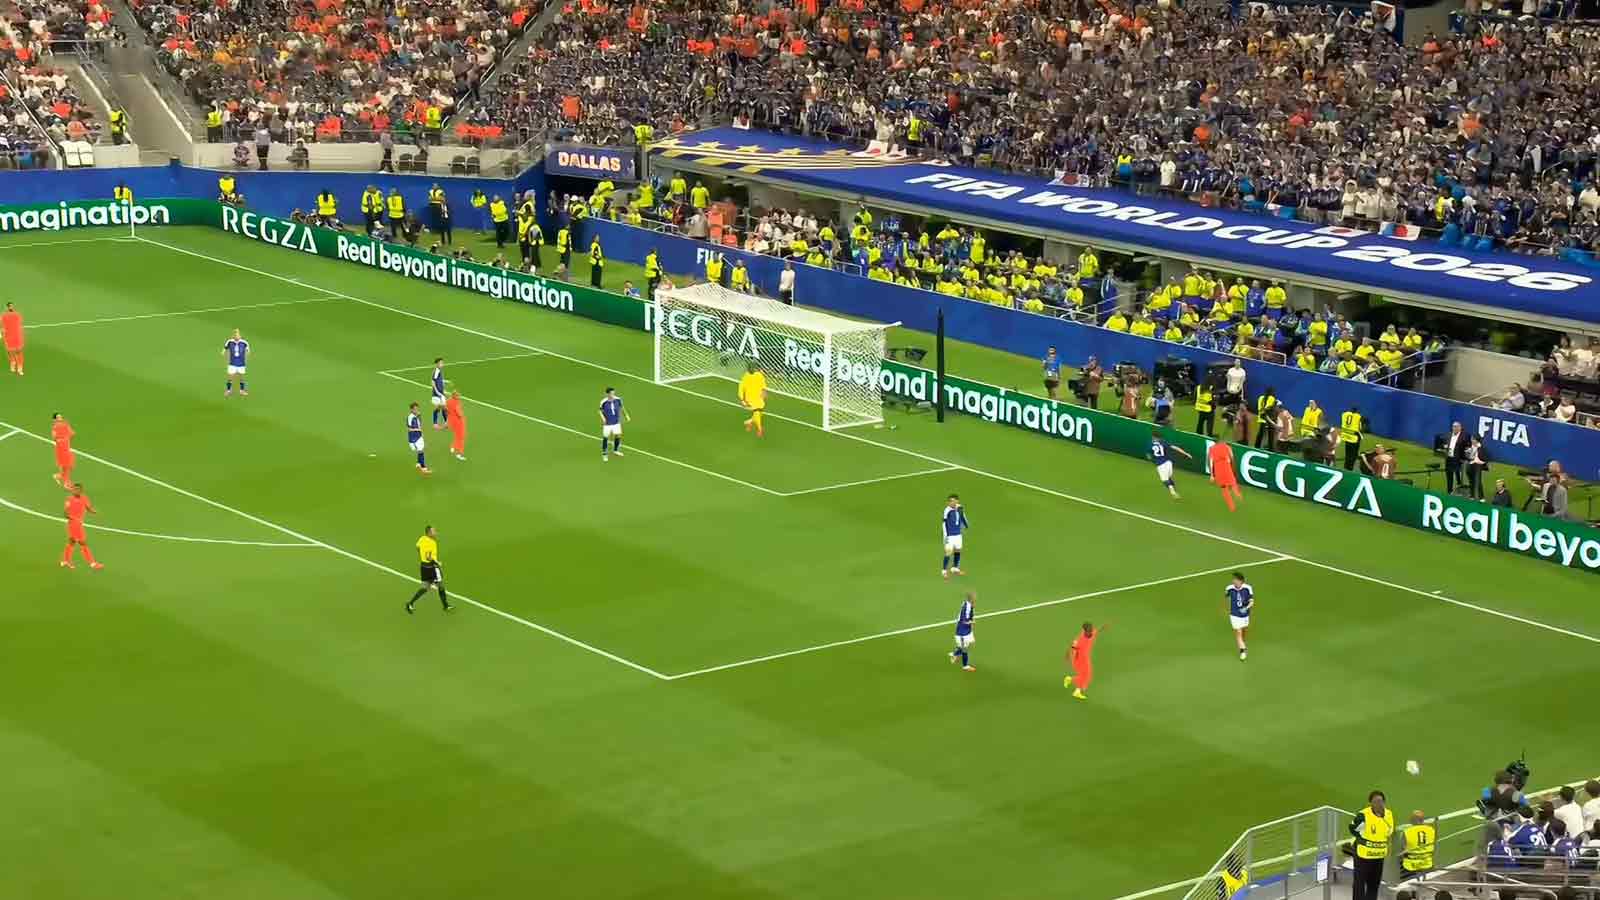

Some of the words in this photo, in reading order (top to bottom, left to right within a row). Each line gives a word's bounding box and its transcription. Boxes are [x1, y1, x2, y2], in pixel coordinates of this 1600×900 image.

[558, 151, 621, 172] DALLAS
[904, 172, 1023, 200] FIFA
[1018, 191, 1223, 232] WORLD
[1212, 225, 1348, 249] CUP
[1332, 245, 1593, 291] 2026
[222, 206, 318, 255] REGZA
[337, 234, 376, 266] Real
[379, 240, 448, 284] beyond
[451, 259, 574, 312] imagination
[837, 350, 926, 401] beyond
[932, 371, 1093, 444] imagination
[1422, 493, 1499, 545] Real
[1509, 512, 1600, 569] beyo
[1477, 415, 1531, 448] FIFA
[1152, 445, 1165, 457] 21
